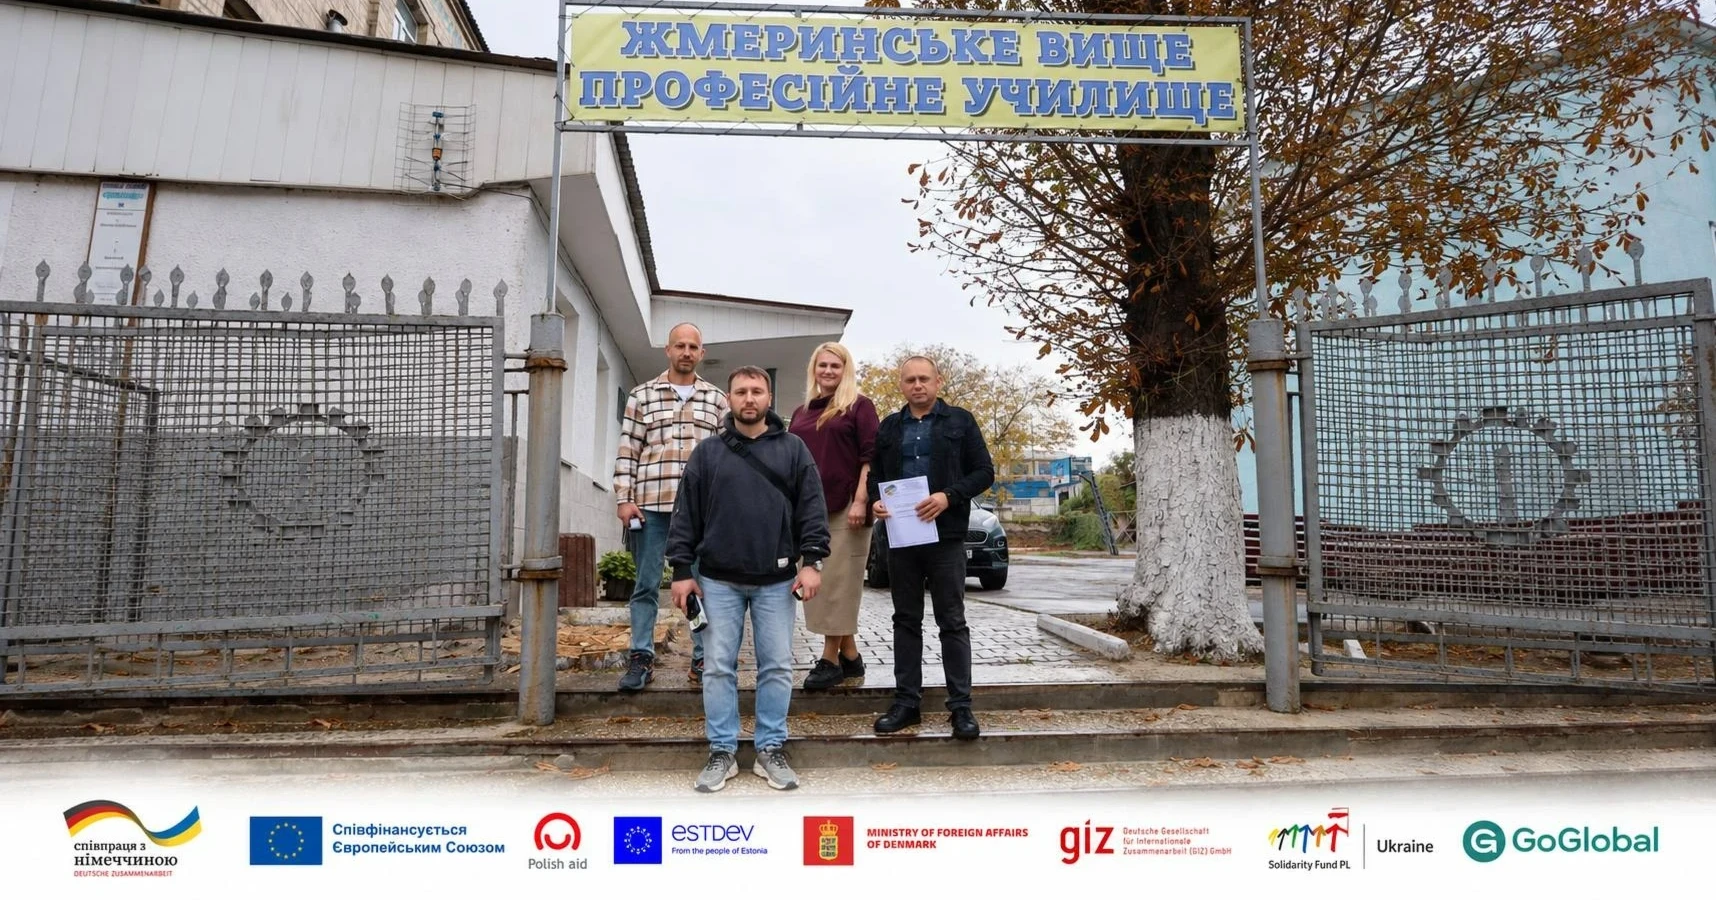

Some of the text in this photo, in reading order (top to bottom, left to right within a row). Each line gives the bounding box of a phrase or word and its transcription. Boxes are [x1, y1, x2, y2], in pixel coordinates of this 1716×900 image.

[620, 21, 1195, 76] ЖМЕРИНСЬКЕ ВИЩЕ
[579, 63, 1237, 125] ПРОФЕСІЙНЕ УЧИЛИЩЕ
